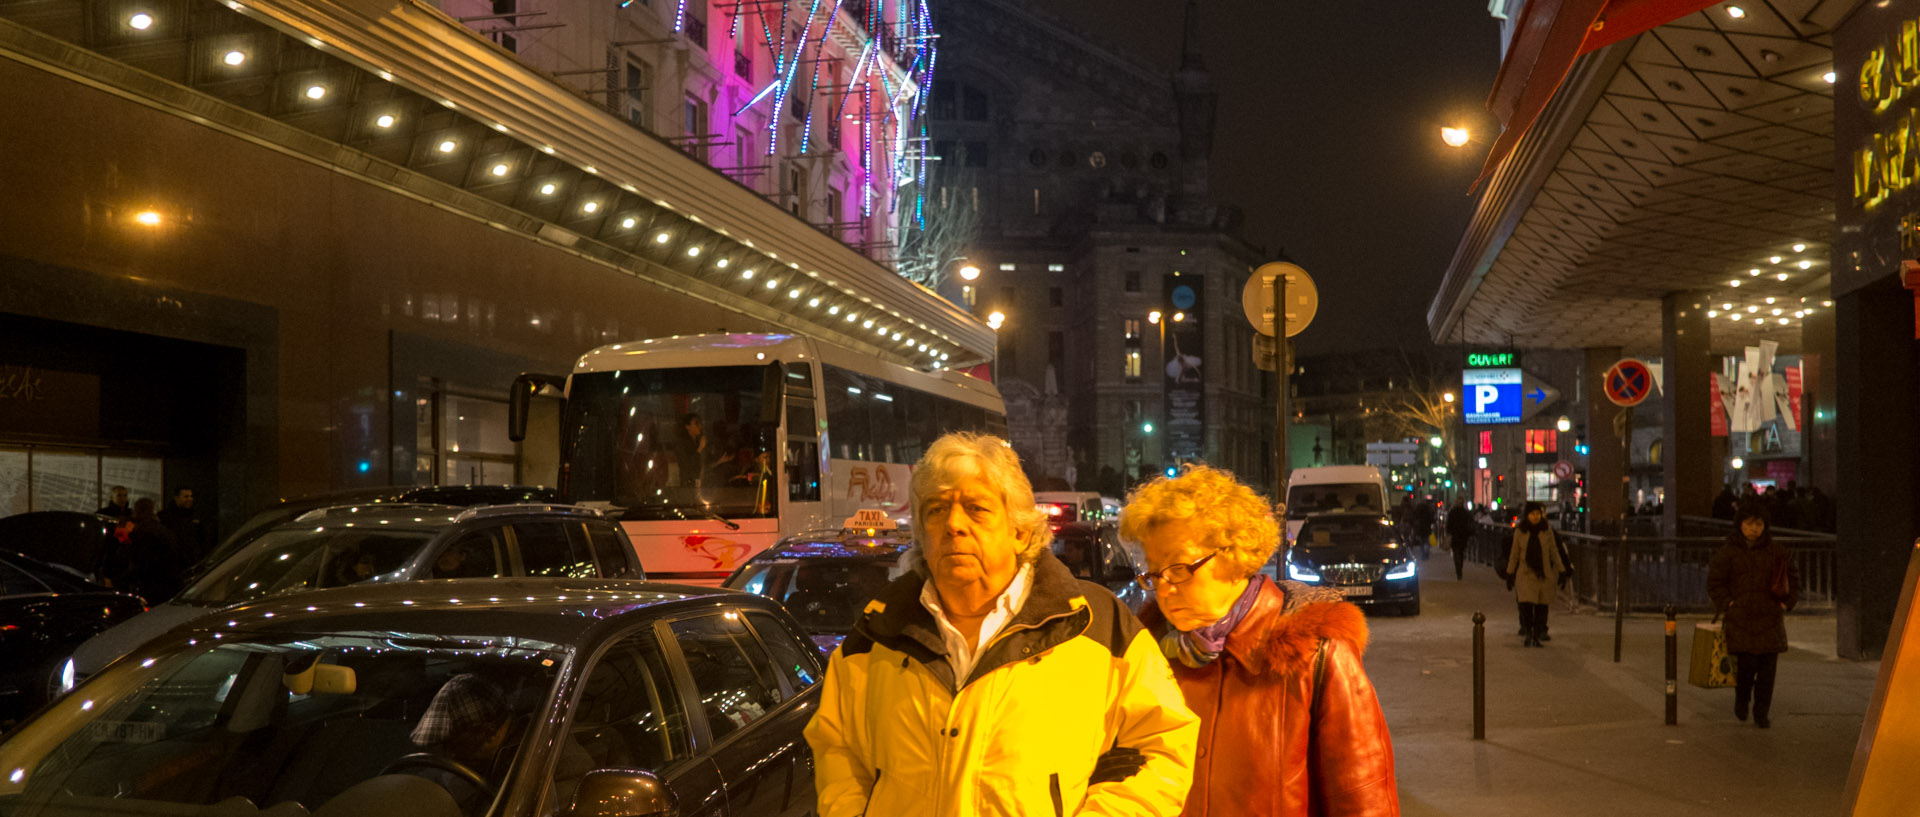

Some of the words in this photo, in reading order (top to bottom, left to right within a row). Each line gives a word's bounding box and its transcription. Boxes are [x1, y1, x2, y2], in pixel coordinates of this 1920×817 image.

[1468, 353, 1514, 366] OUVERT
[1475, 384, 1499, 413] P
[859, 511, 880, 521] TAXI
